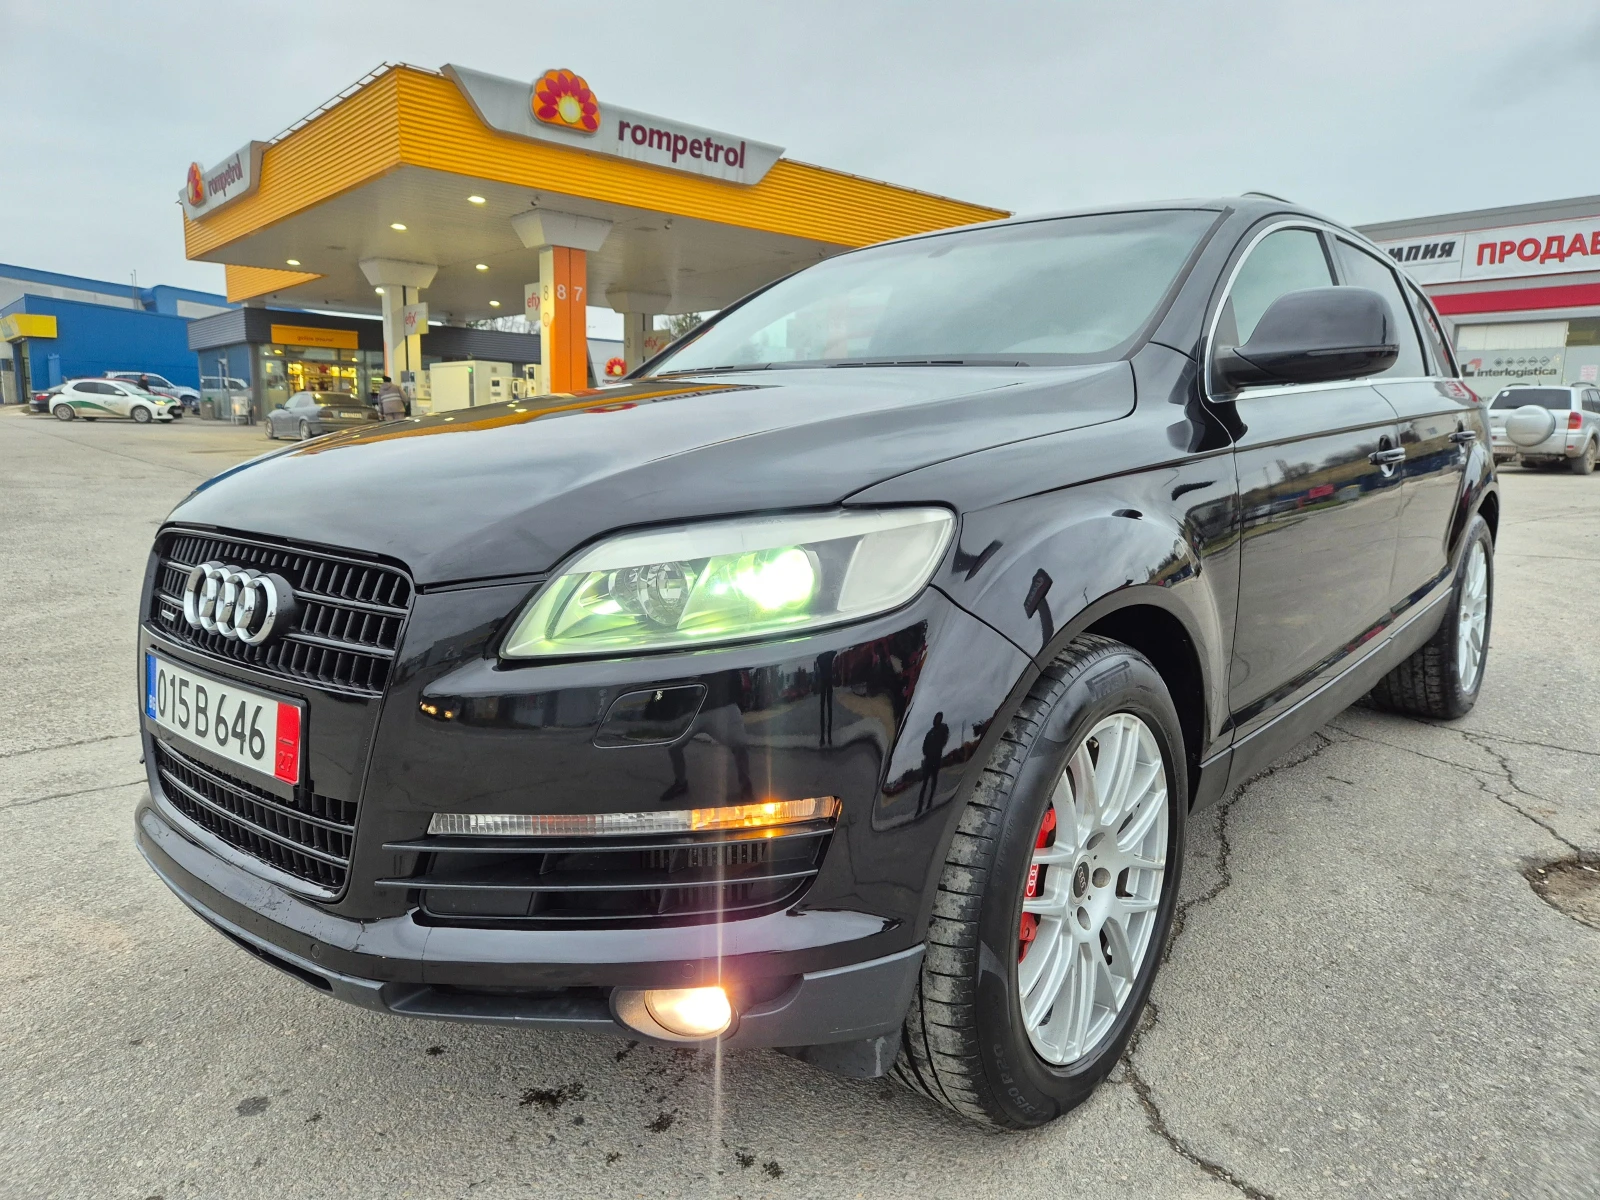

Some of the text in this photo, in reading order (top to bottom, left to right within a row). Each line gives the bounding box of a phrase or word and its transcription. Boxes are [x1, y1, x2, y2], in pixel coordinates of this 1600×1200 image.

[618, 120, 746, 169] rompetrol
[207, 153, 243, 197] rompetrol
[557, 284, 567, 301] 8
[574, 286, 583, 302] 7
[644, 336, 659, 349] efix
[1477, 367, 1557, 378] interlogistica
